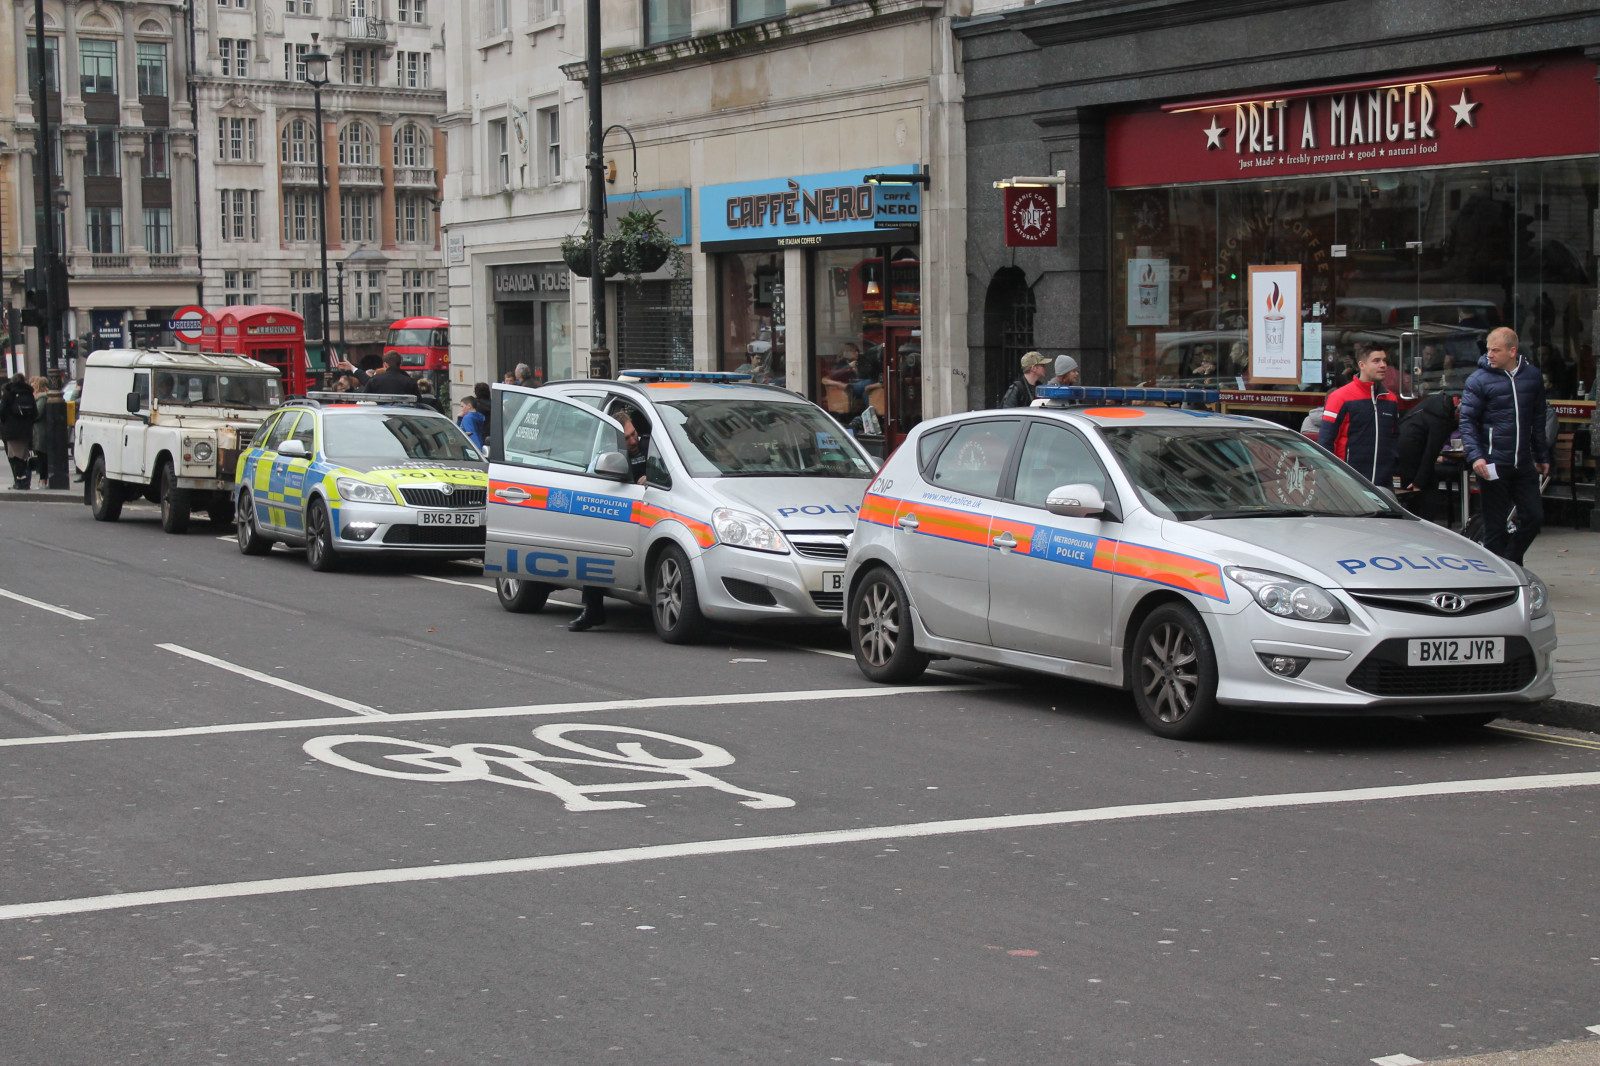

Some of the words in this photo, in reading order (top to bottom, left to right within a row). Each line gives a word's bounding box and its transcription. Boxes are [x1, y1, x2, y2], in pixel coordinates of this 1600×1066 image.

[1235, 101, 1288, 153] PRET
[1301, 101, 1316, 149] A
[1330, 84, 1435, 146] MANGER
[1287, 154, 1311, 165] freshly
[1313, 150, 1346, 164] prepared
[1357, 149, 1376, 160] good
[1388, 145, 1417, 157] natural
[1419, 143, 1438, 154] food
[803, 183, 875, 224] NERO
[877, 204, 918, 215] NERO
[1012, 193, 1032, 215] ORGANIC
[1034, 194, 1051, 214] COFFEE
[1014, 223, 1038, 240] NATURAL
[1039, 223, 1051, 238] FOOD
[801, 237, 816, 245] COFFEE
[496, 274, 535, 292] UGANDA
[391, 472, 486, 482] POLICE
[872, 477, 894, 494] CNP
[576, 495, 629, 509] METROPOLITAN
[922, 490, 982, 509] www.met.police.uk
[423, 513, 452, 525] BX62
[454, 513, 475, 525] BZG
[582, 505, 620, 517] POLICE
[1053, 534, 1094, 550] METROPOLITAN
[1056, 546, 1086, 561] POLICE
[1336, 556, 1497, 575] POLICE
[1419, 641, 1459, 662] BX12
[1463, 640, 1495, 660] JYR
